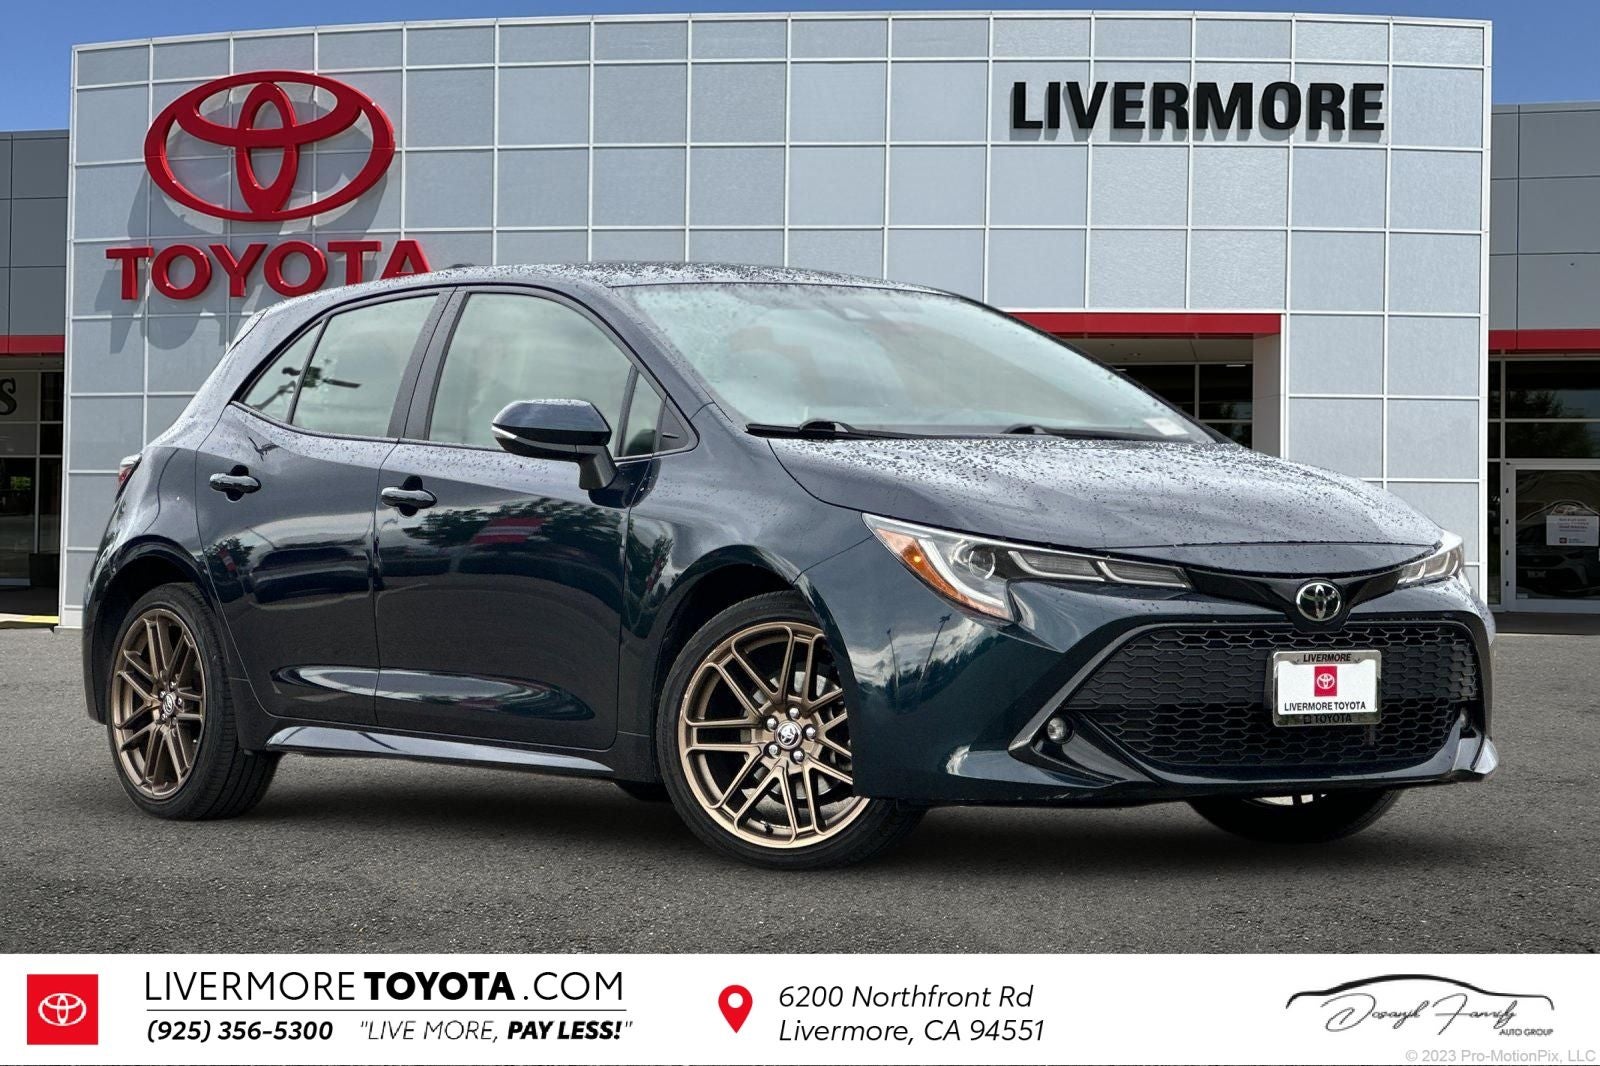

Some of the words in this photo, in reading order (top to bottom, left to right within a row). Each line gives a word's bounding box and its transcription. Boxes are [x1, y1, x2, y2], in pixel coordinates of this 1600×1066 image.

[1012, 81, 1385, 131] LIVERMORE
[105, 239, 432, 301] TOYOTA
[1303, 653, 1352, 663] LIVERMORE
[1284, 702, 1333, 711] LIVERMORE
[1334, 701, 1366, 710] TOYOTA
[1314, 713, 1352, 723] TOYOTA
